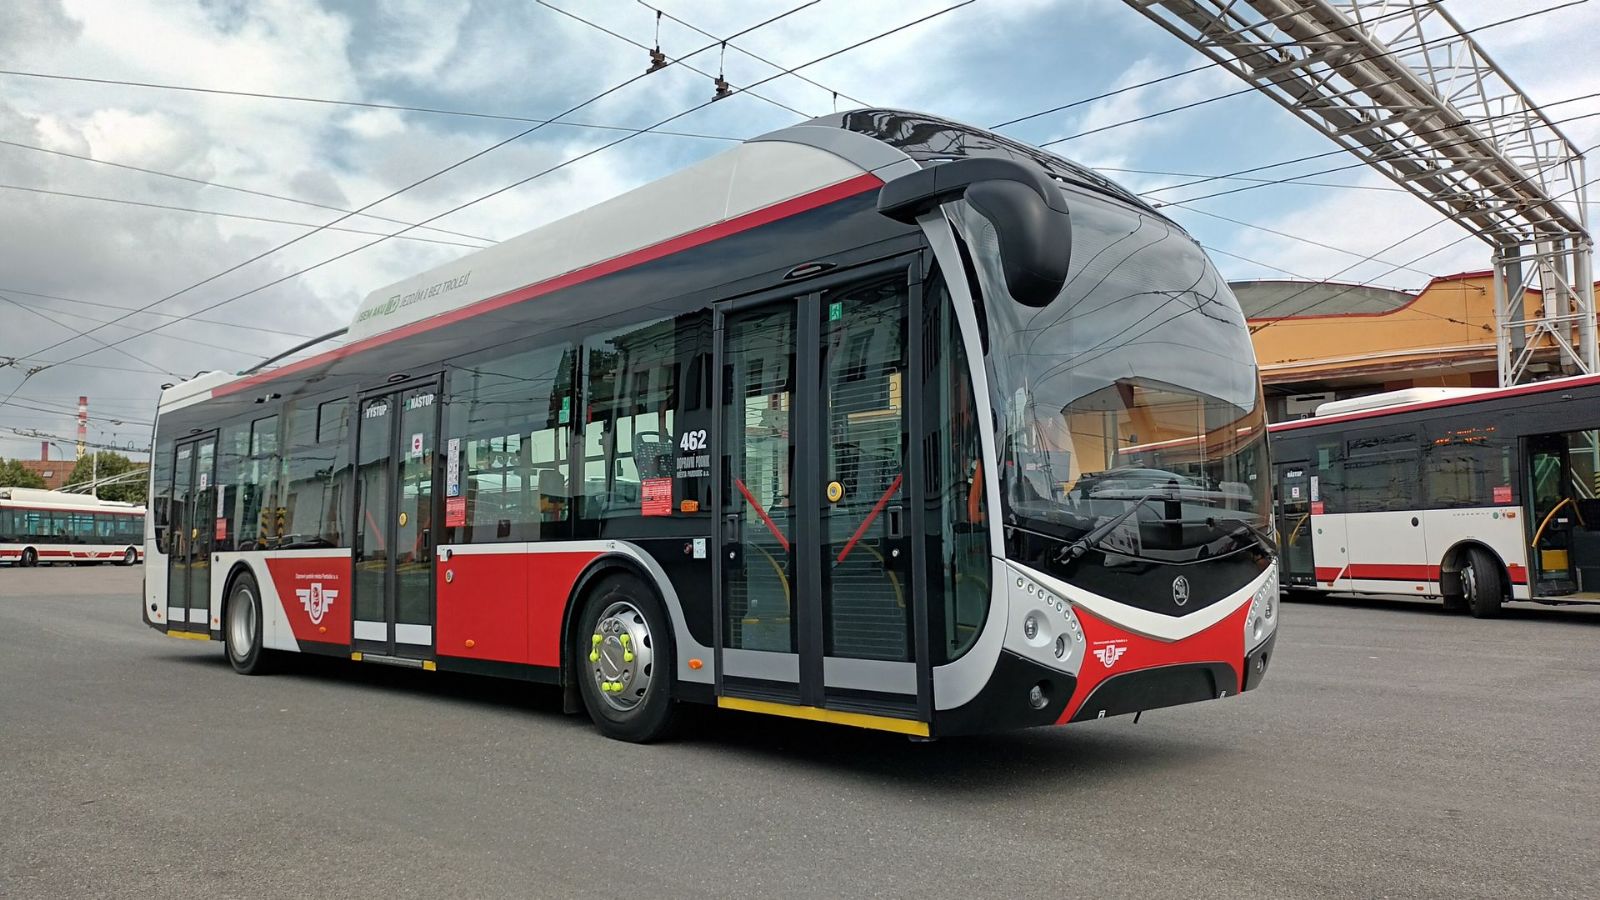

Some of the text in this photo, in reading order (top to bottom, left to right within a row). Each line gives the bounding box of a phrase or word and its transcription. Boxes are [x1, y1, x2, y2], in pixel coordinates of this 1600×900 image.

[411, 394, 435, 409] NÁSTUP
[366, 404, 388, 418] VÝSTUP
[680, 429, 707, 451] 462
